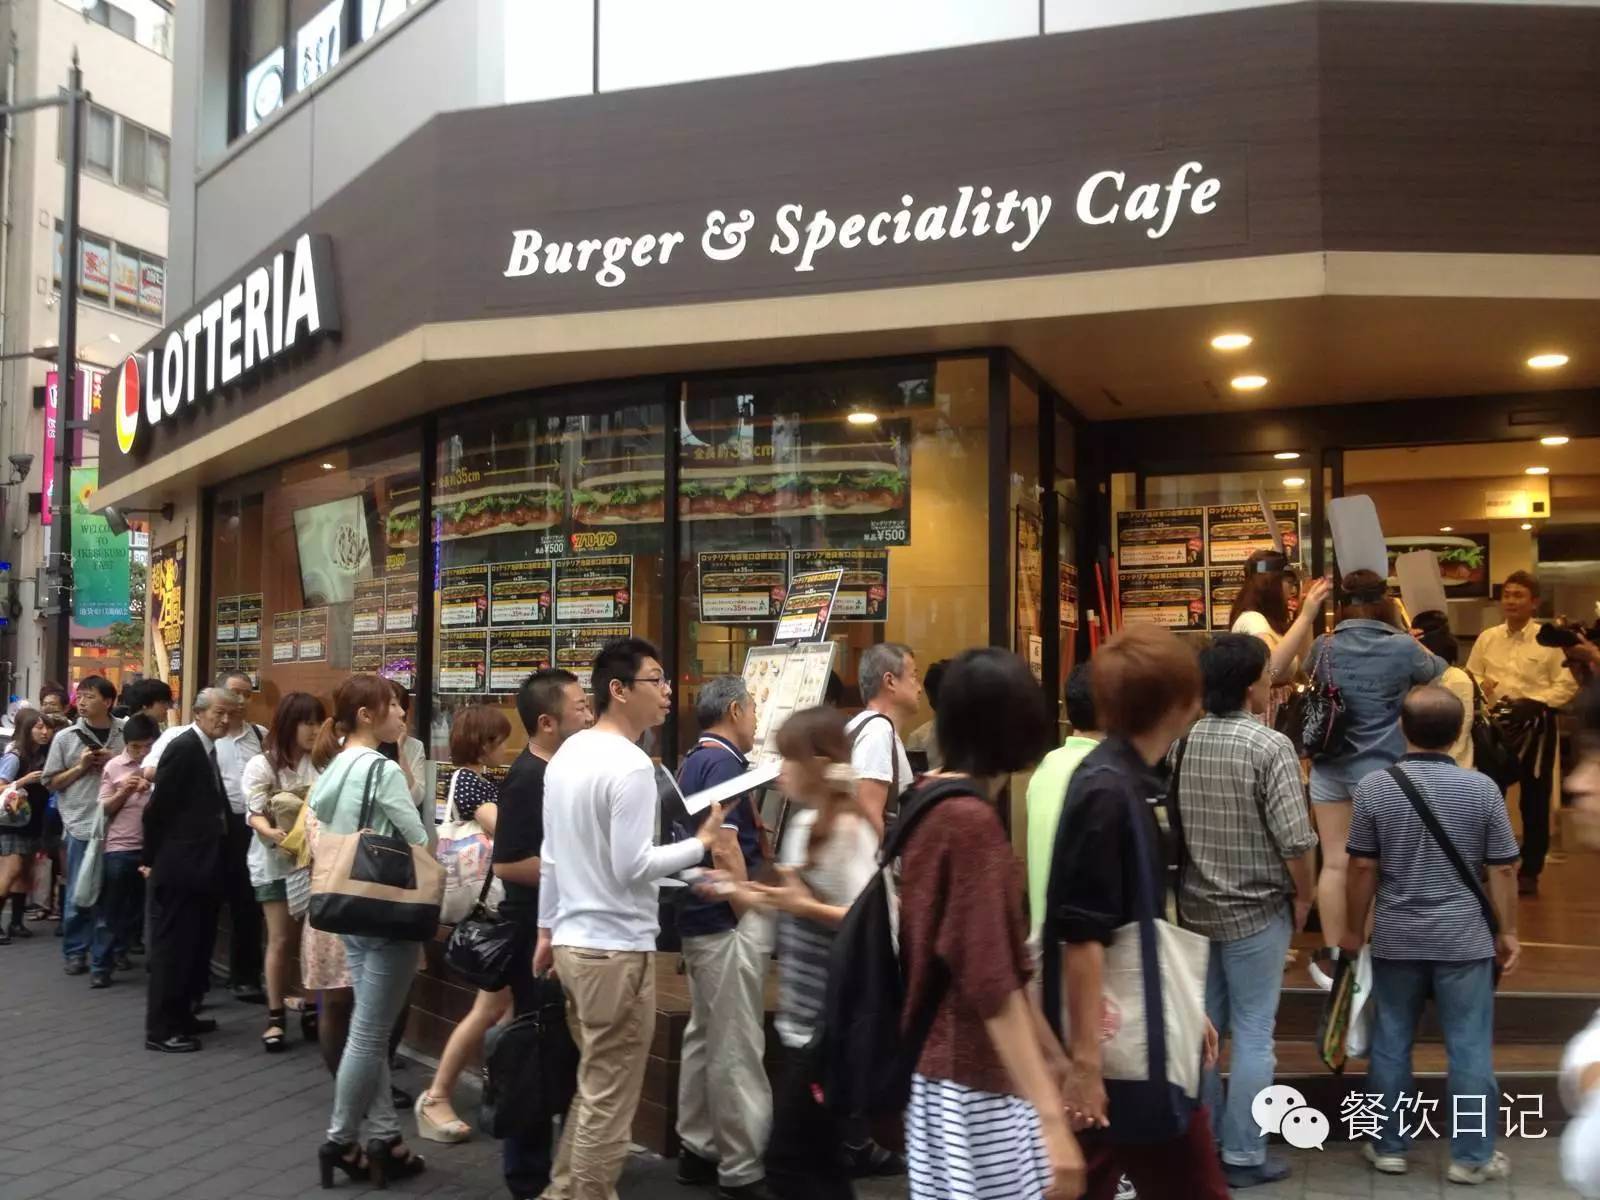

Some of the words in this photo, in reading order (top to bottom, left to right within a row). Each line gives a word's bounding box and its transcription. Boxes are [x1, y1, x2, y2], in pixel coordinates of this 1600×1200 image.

[503, 229, 685, 287] Burger
[701, 209, 755, 261] &
[769, 185, 1052, 272] Speciality
[1076, 161, 1221, 239] Cafe
[145, 232, 320, 425] LOTTERIA
